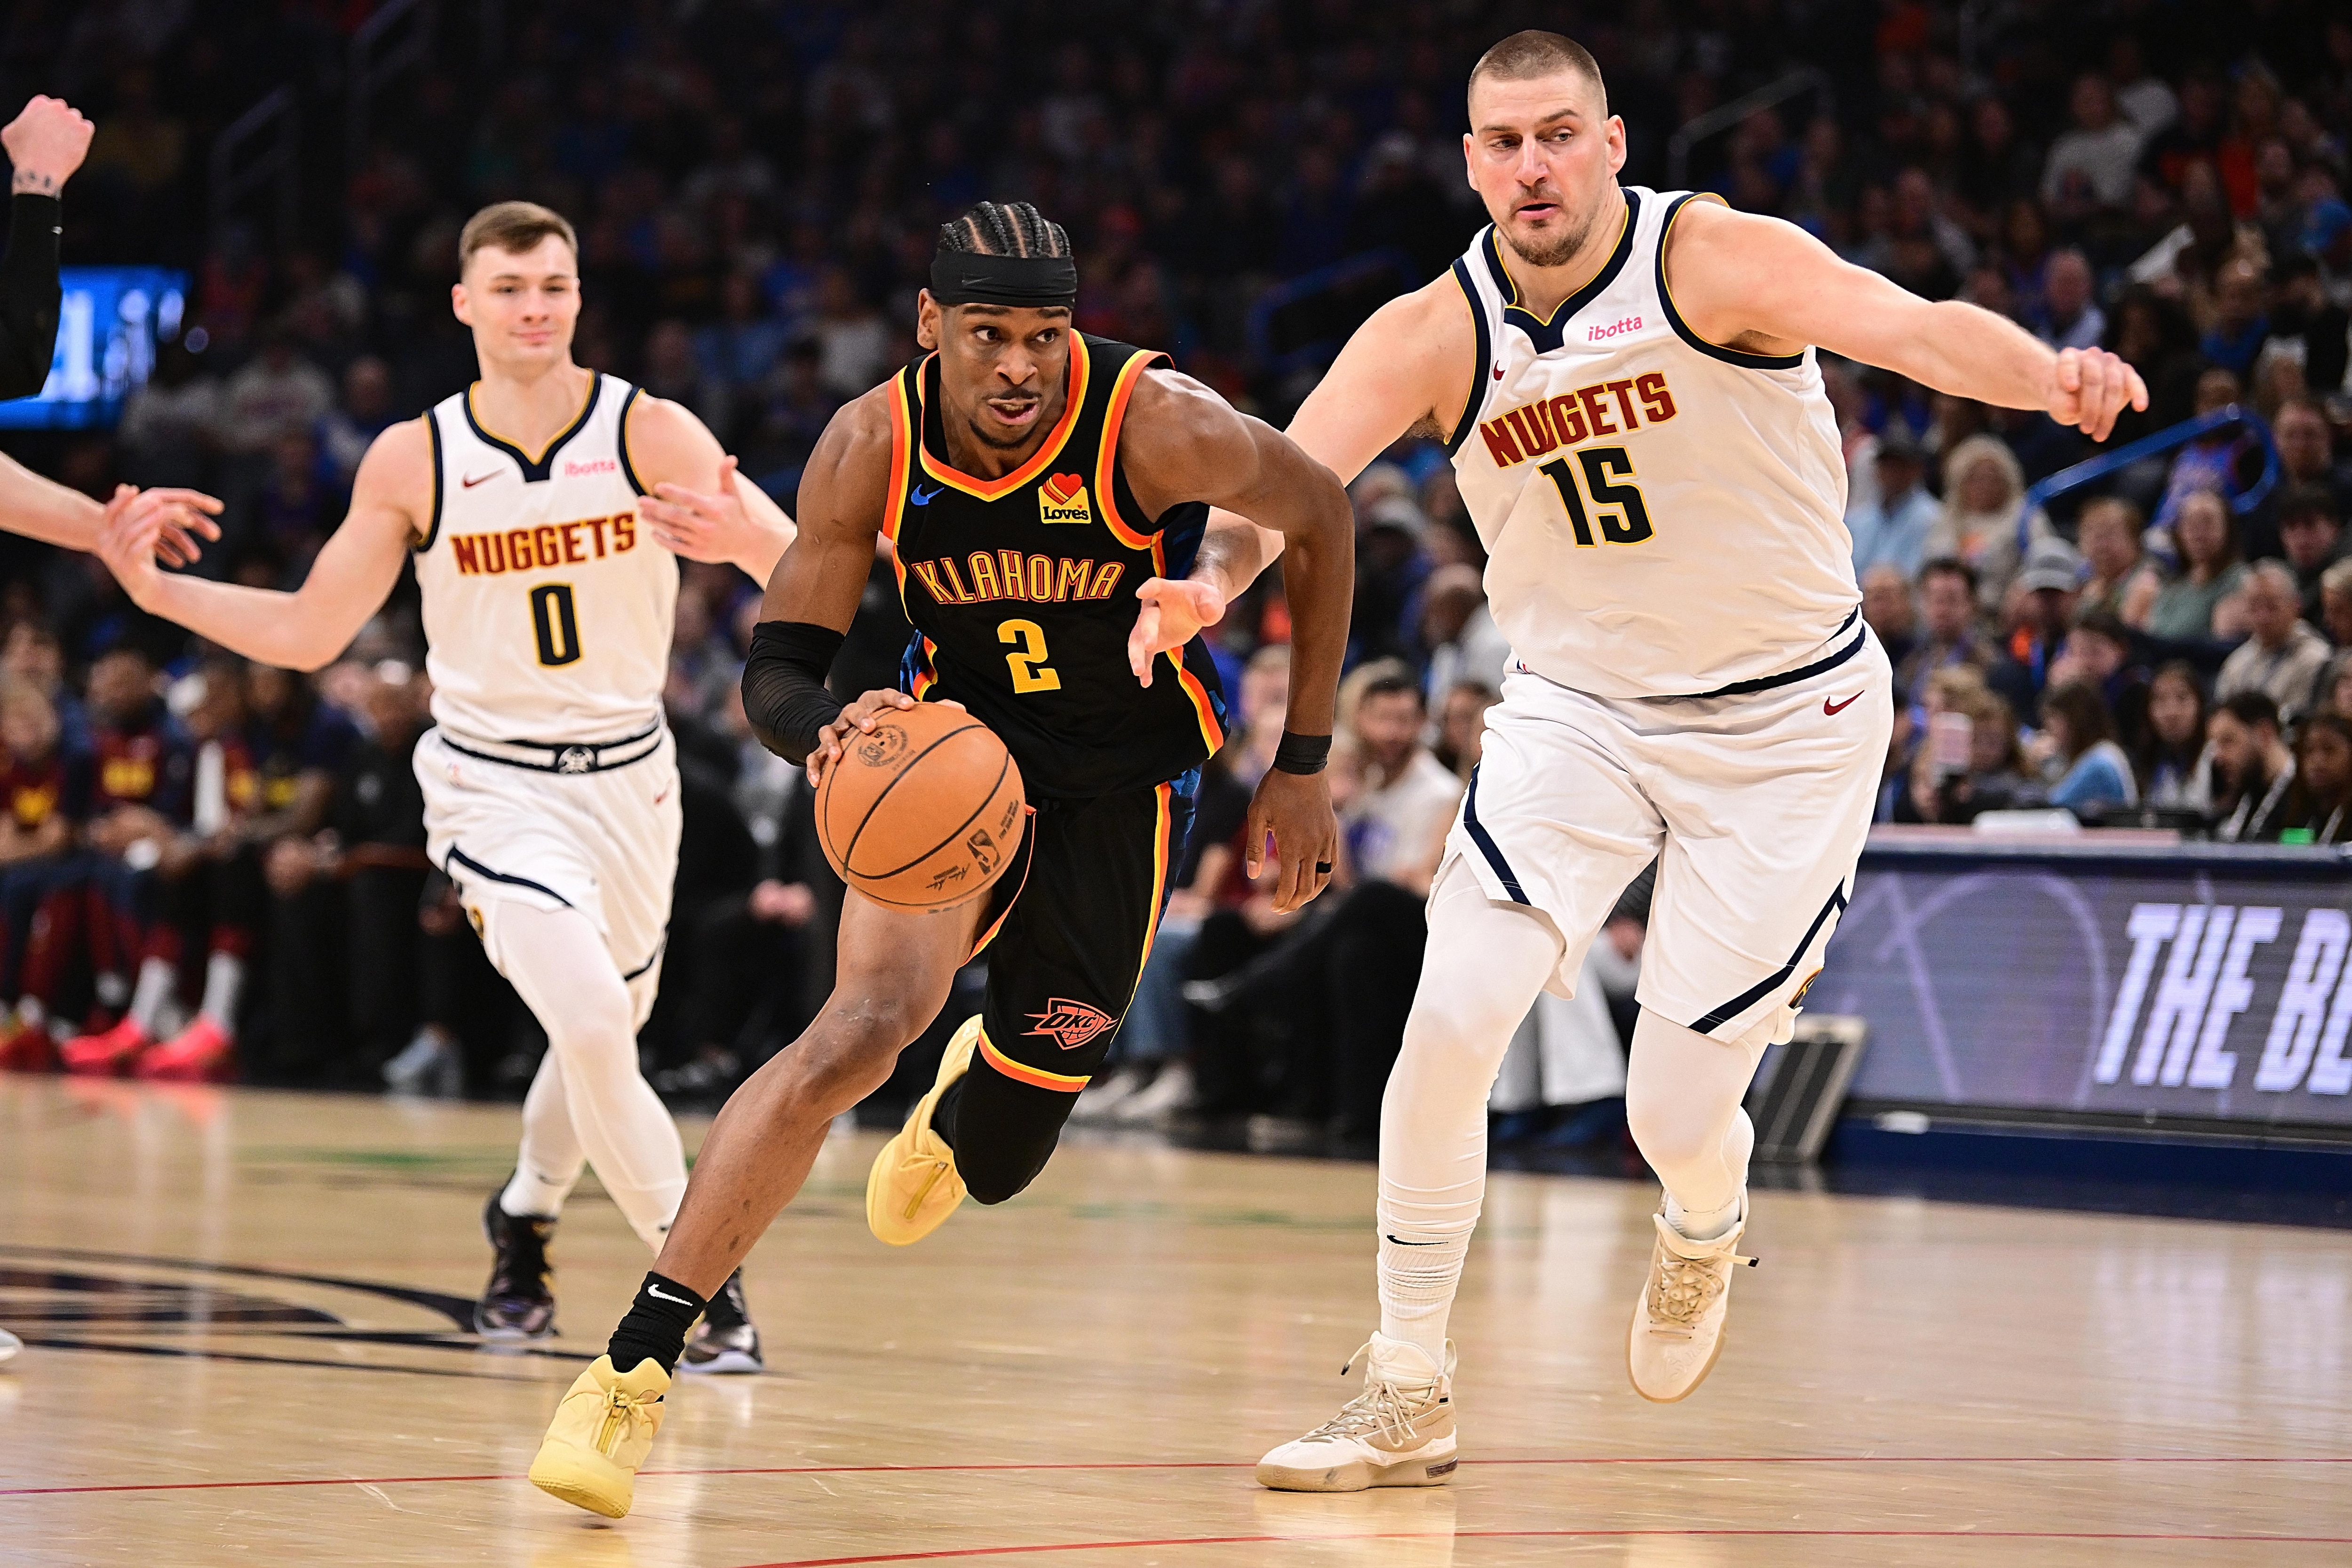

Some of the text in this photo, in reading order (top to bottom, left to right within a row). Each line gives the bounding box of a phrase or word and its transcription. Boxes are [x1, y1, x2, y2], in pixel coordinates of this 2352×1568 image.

[1588, 317, 1642, 341] ibotta
[1535, 446, 1656, 548] 15
[449, 511, 636, 576] NUGGETS
[911, 549, 1125, 604] KLAHOMA
[529, 583, 582, 669] 0
[997, 619, 1061, 693] 2
[1039, 1012, 1097, 1029] OKC
[2093, 902, 2283, 1089] THE
